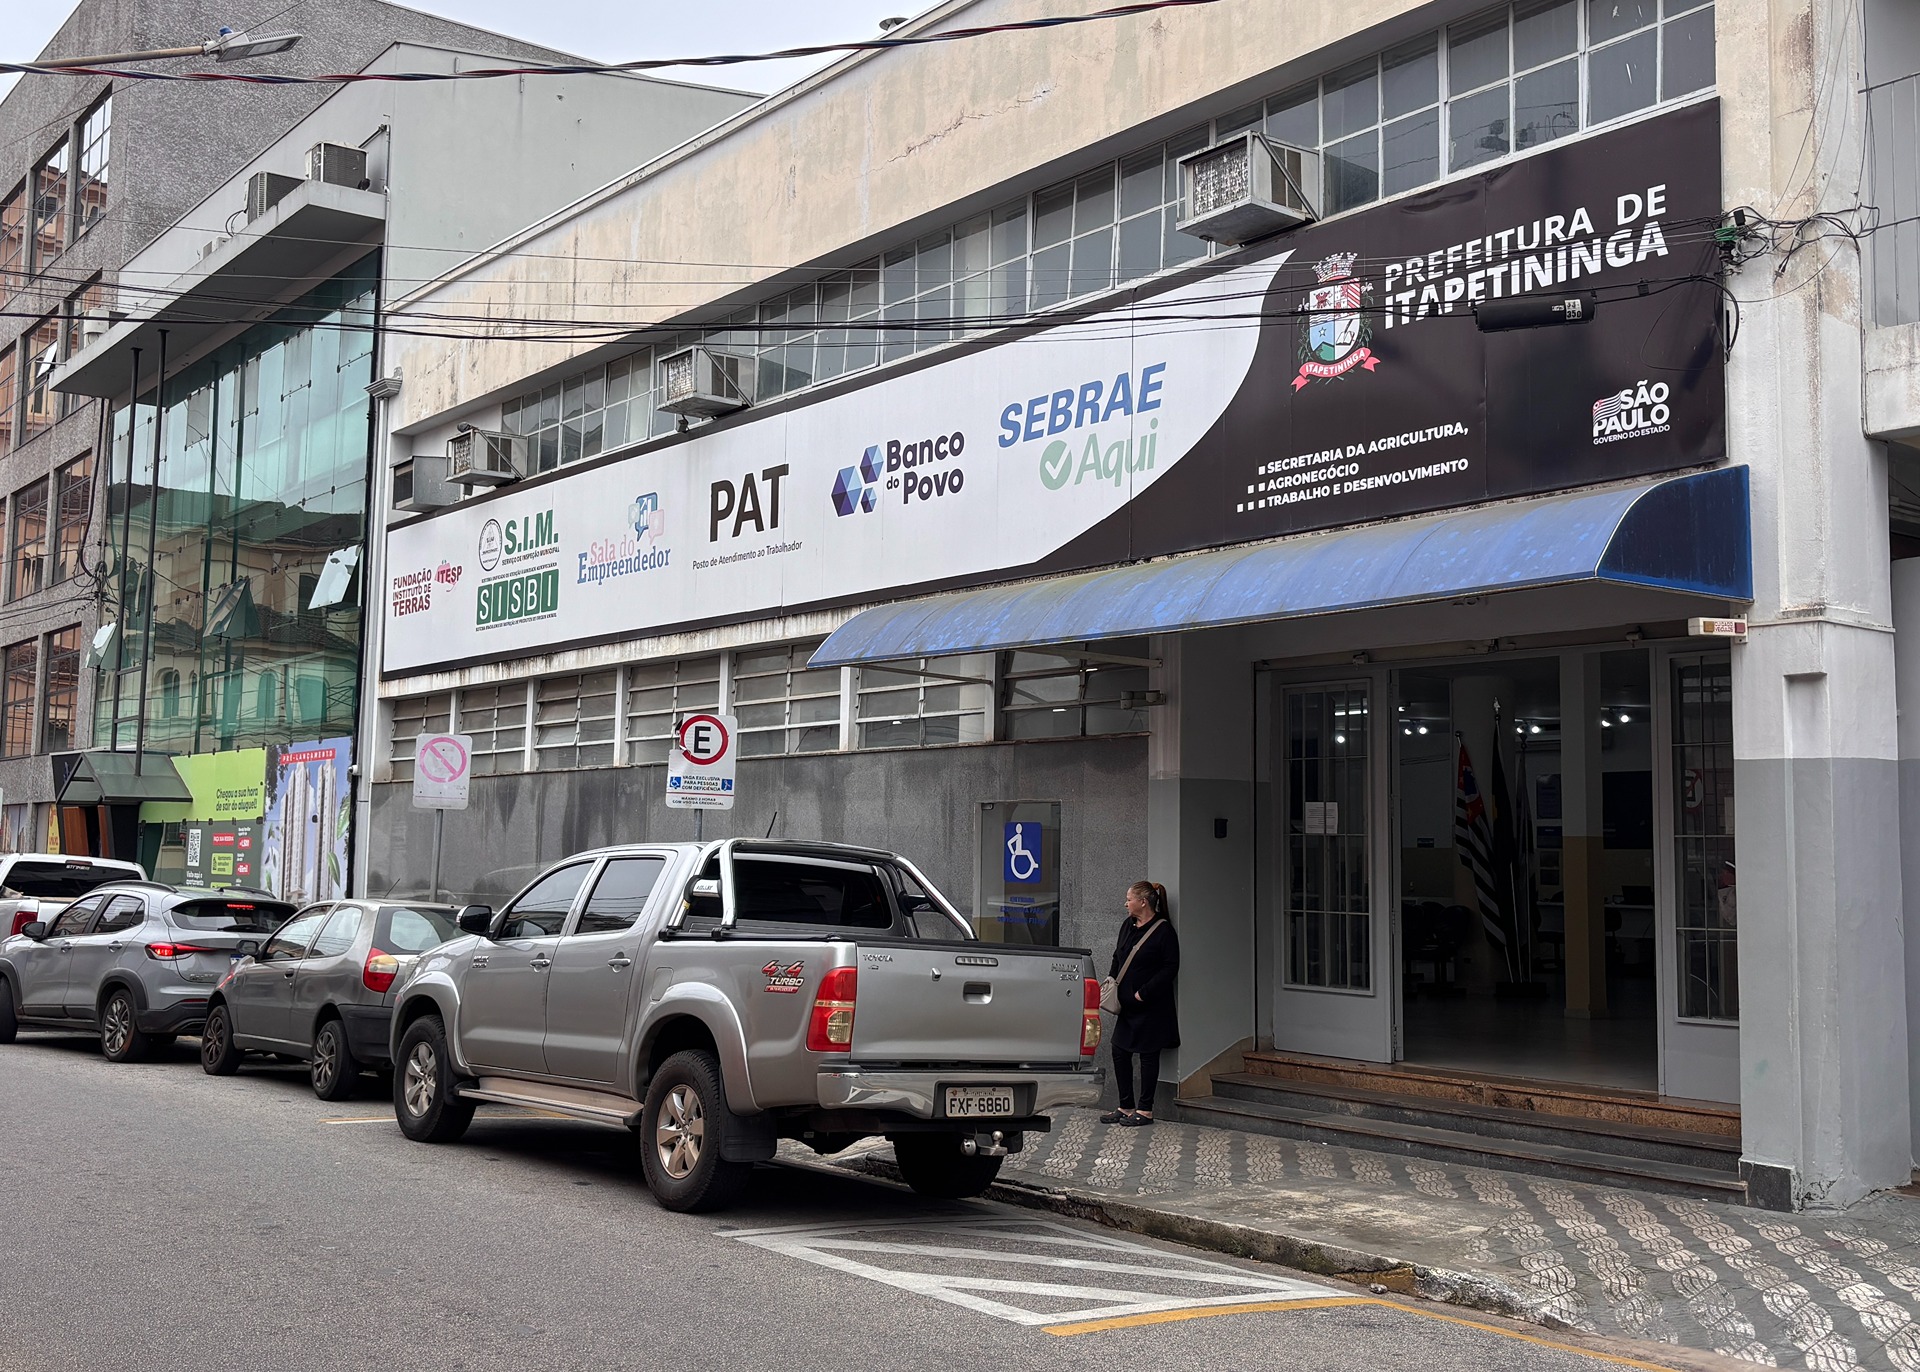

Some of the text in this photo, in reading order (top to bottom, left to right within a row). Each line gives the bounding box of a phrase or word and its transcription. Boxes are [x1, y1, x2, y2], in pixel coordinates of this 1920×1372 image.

[1385, 183, 1667, 292] PREFEITURA DE
[1384, 221, 1669, 329] ITAPETININGA
[1305, 349, 1366, 375] ITAPETININGA
[998, 361, 1167, 448] SEBRAE
[1620, 379, 1670, 410] SÃO
[1592, 403, 1670, 438] PAULO
[1593, 424, 1670, 445] GOVERNO DO ESTADO
[886, 431, 965, 473] Banco
[1074, 417, 1159, 488] Aqui
[1267, 421, 1469, 474] SECRETARIA DA AGRICULTURA,
[886, 475, 900, 490] do
[903, 468, 964, 505] Povo
[1267, 462, 1359, 491] AGRONEGÓCIO
[1267, 458, 1469, 507] TRABALHO E DESENVOLVIMENTO
[709, 463, 789, 543] PAT
[504, 509, 559, 555] S.I.M.
[577, 545, 671, 585] Empreendedor
[590, 534, 635, 565] Sala do
[692, 540, 803, 570] Posto de Atendimento ao Trabalhador
[393, 567, 432, 590] FUNDAÇÃO
[437, 565, 463, 583] ITESP
[392, 583, 432, 602] INSTITUTO DE
[392, 593, 431, 618] TERRAS
[479, 574, 552, 620] SISBI
[693, 725, 712, 754] E
[770, 977, 805, 986] TURBO
